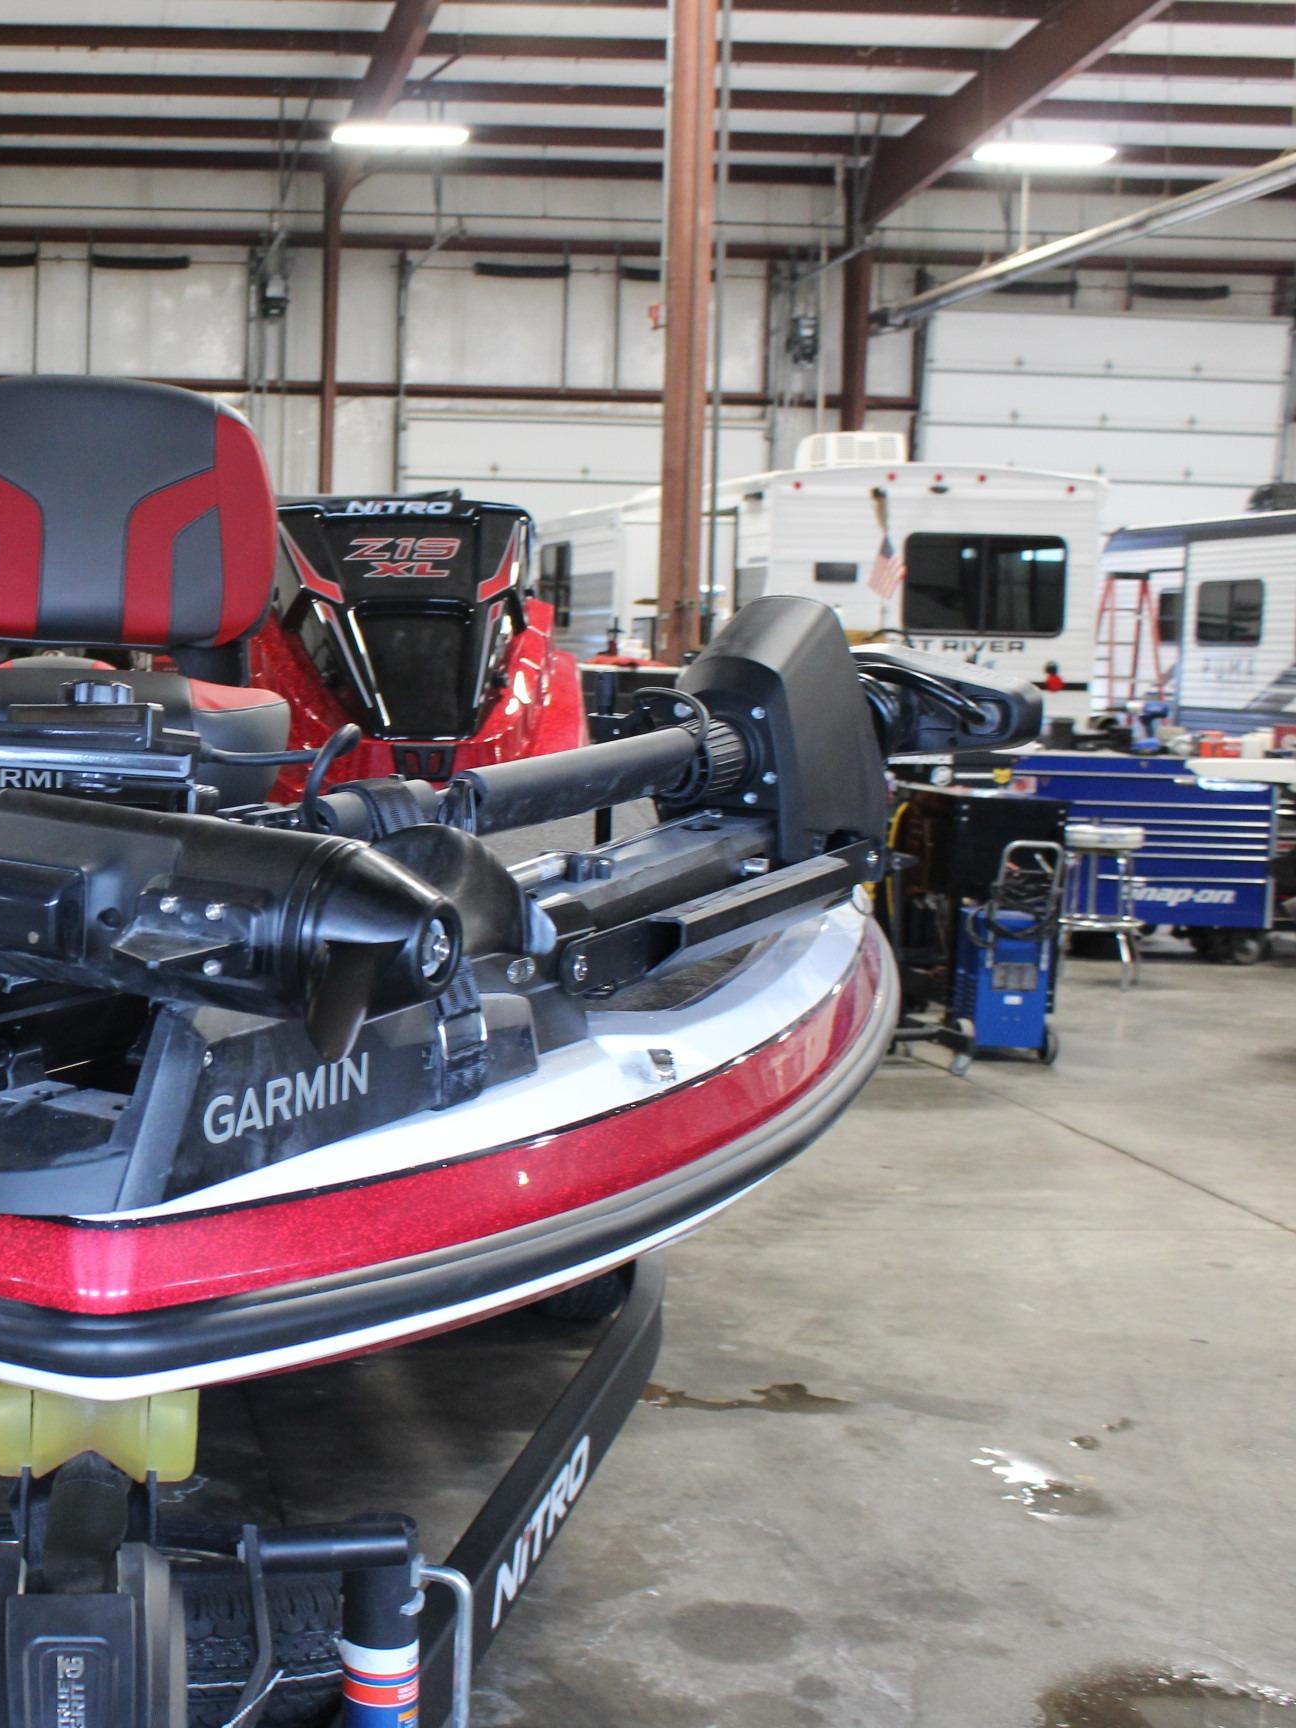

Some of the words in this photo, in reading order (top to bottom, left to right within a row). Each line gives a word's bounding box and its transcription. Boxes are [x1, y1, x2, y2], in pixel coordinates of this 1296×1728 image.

[342, 537, 461, 560] Z19
[362, 561, 450, 577] XL
[941, 639, 1025, 652] RIVER
[203, 1052, 369, 1145] GARMIN
